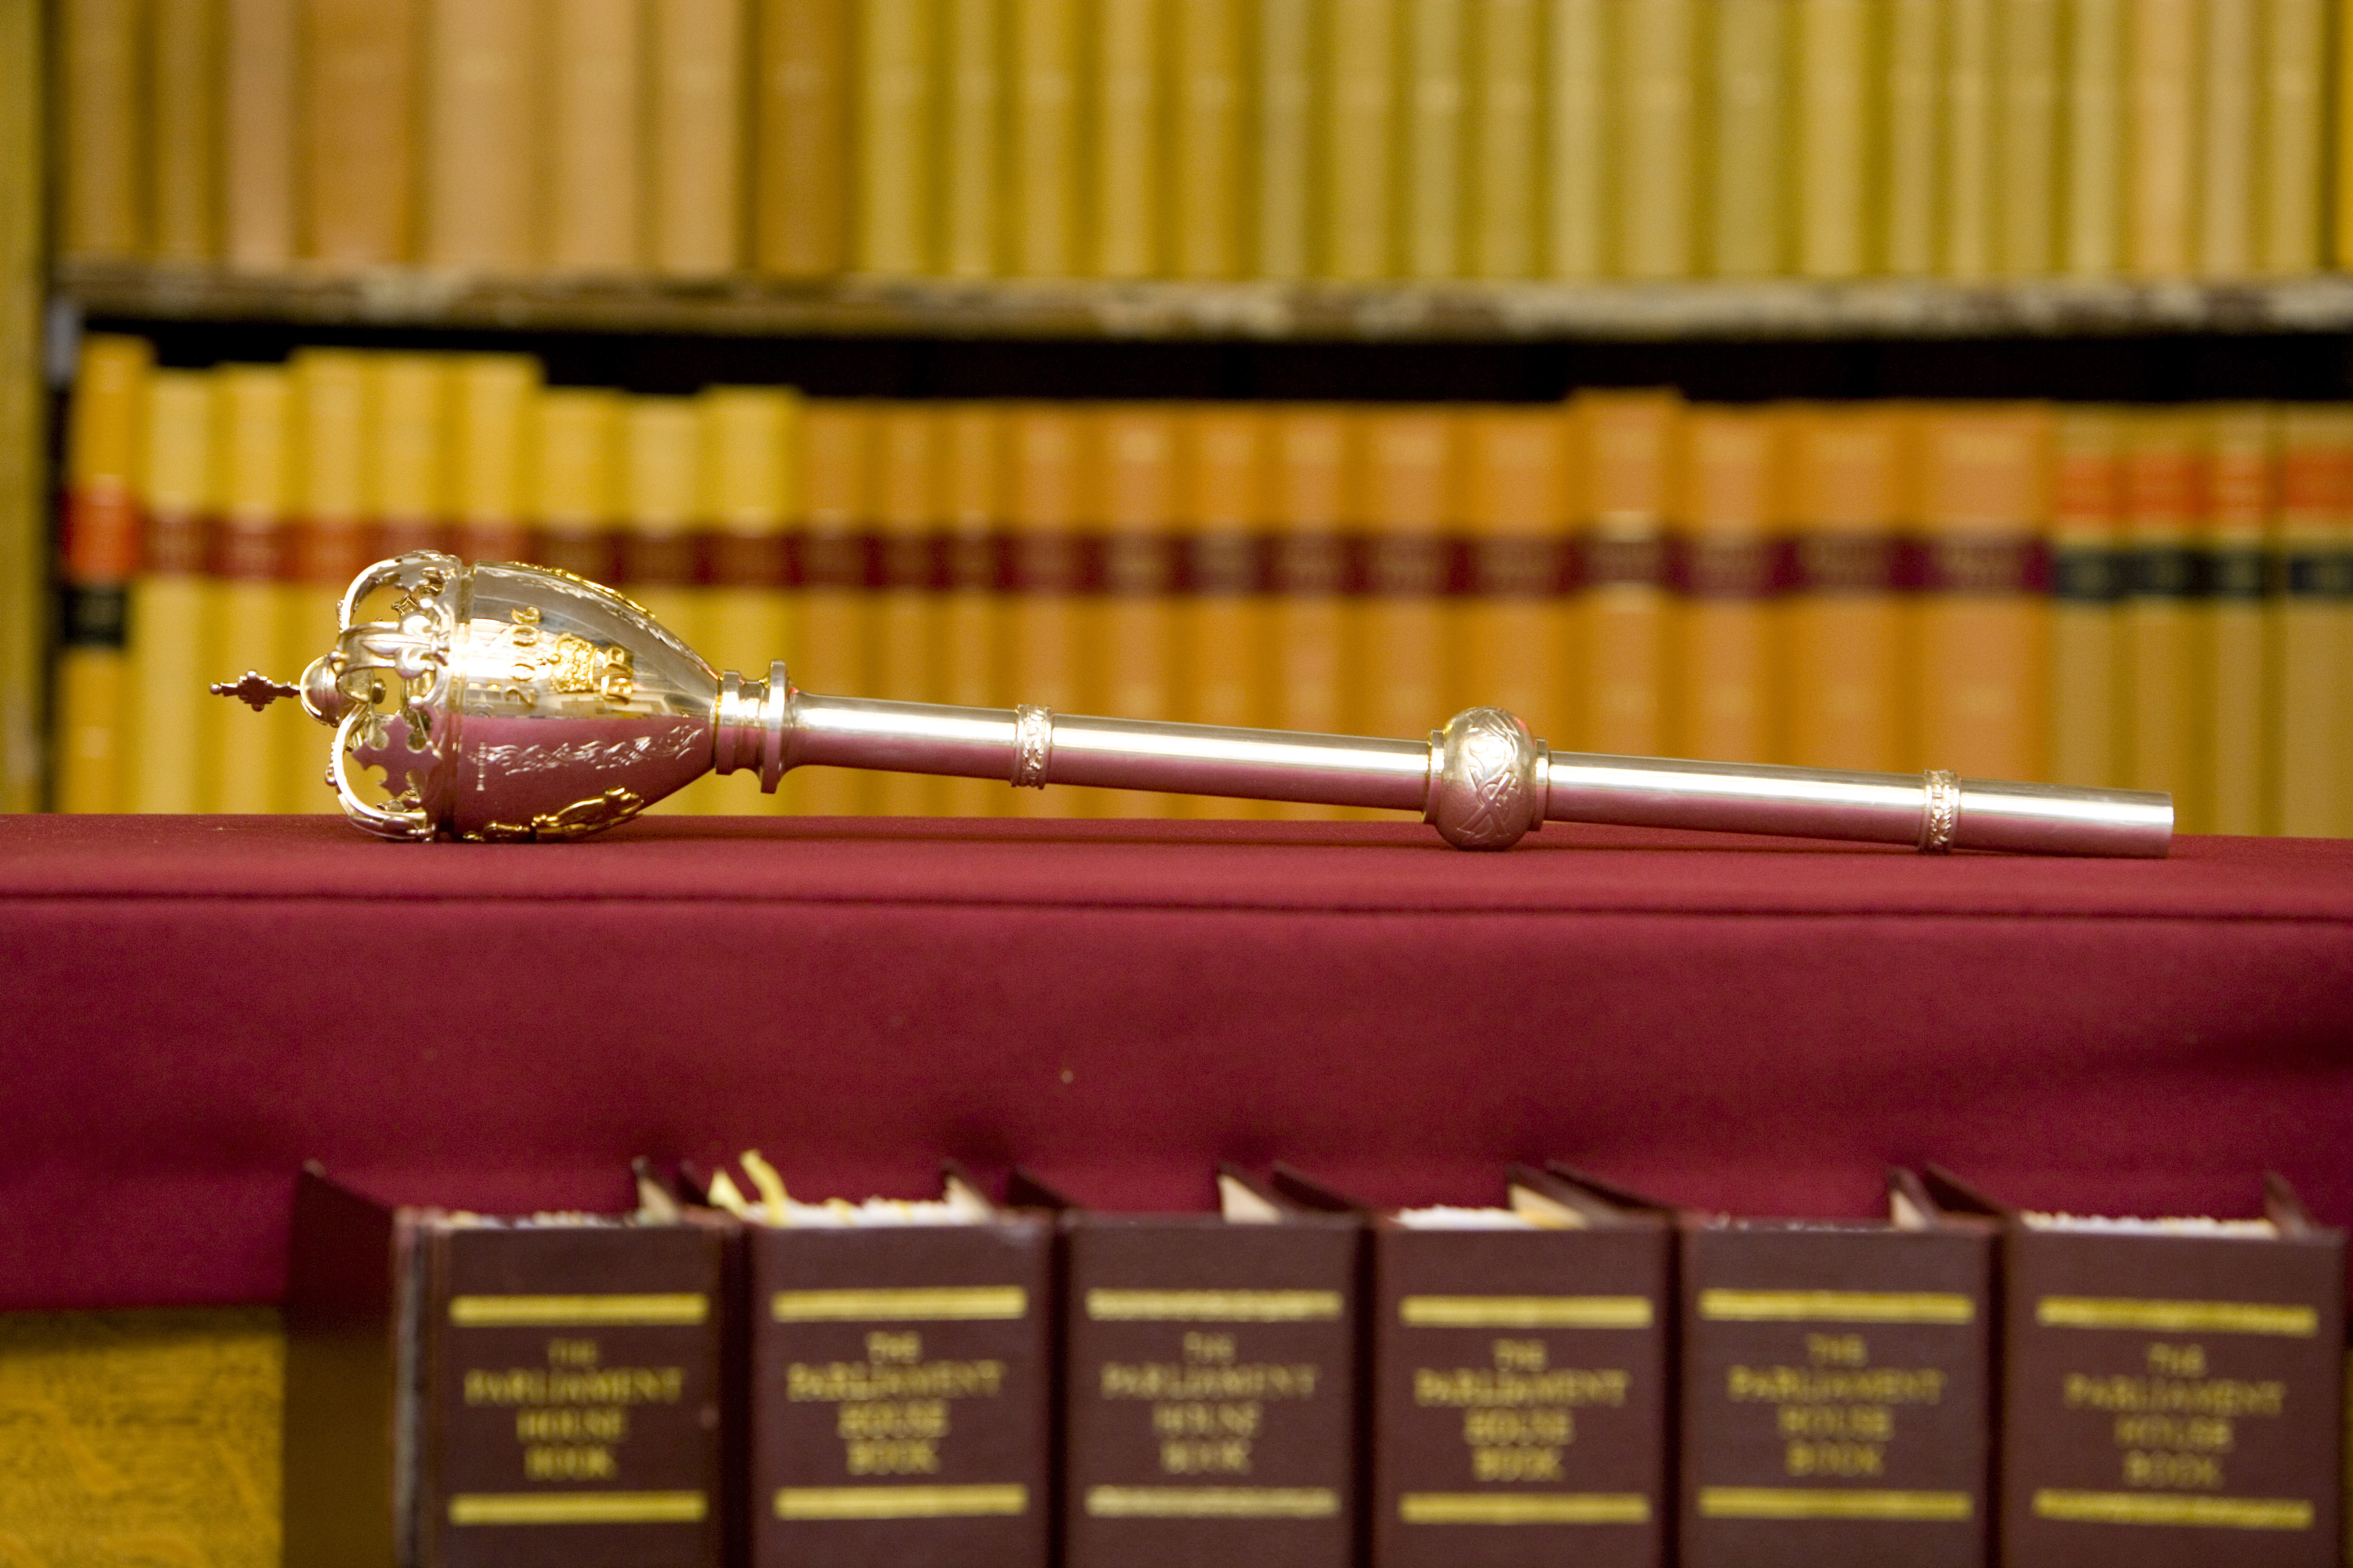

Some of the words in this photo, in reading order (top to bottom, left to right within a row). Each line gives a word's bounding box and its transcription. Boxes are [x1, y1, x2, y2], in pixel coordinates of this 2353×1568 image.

[466, 1369, 680, 1403] PARLIAMENT
[788, 1362, 1001, 1399] PARLIAMENT
[1102, 1366, 1314, 1397] PARLIAMENT
[1416, 1371, 1625, 1404] PARLIAMENT
[1729, 1369, 1942, 1403] PARLIAMENT
[2066, 1374, 2283, 1414] PARLIAMENT
[518, 1409, 624, 1440] HOUSE
[839, 1403, 946, 1437] HOUSE
[1153, 1405, 1259, 1435] HOUSE
[1466, 1411, 1570, 1444] HOUSE
[1780, 1408, 1890, 1439] HOUSE
[2117, 1418, 2230, 1451] HOUSE
[526, 1447, 613, 1478] BOOK
[848, 1441, 934, 1473] BOOK
[1162, 1440, 1248, 1472] BOOK
[1474, 1448, 1558, 1480] BOOK
[1787, 1444, 1879, 1475] BOOK
[2125, 1453, 2218, 1486] BOOK
